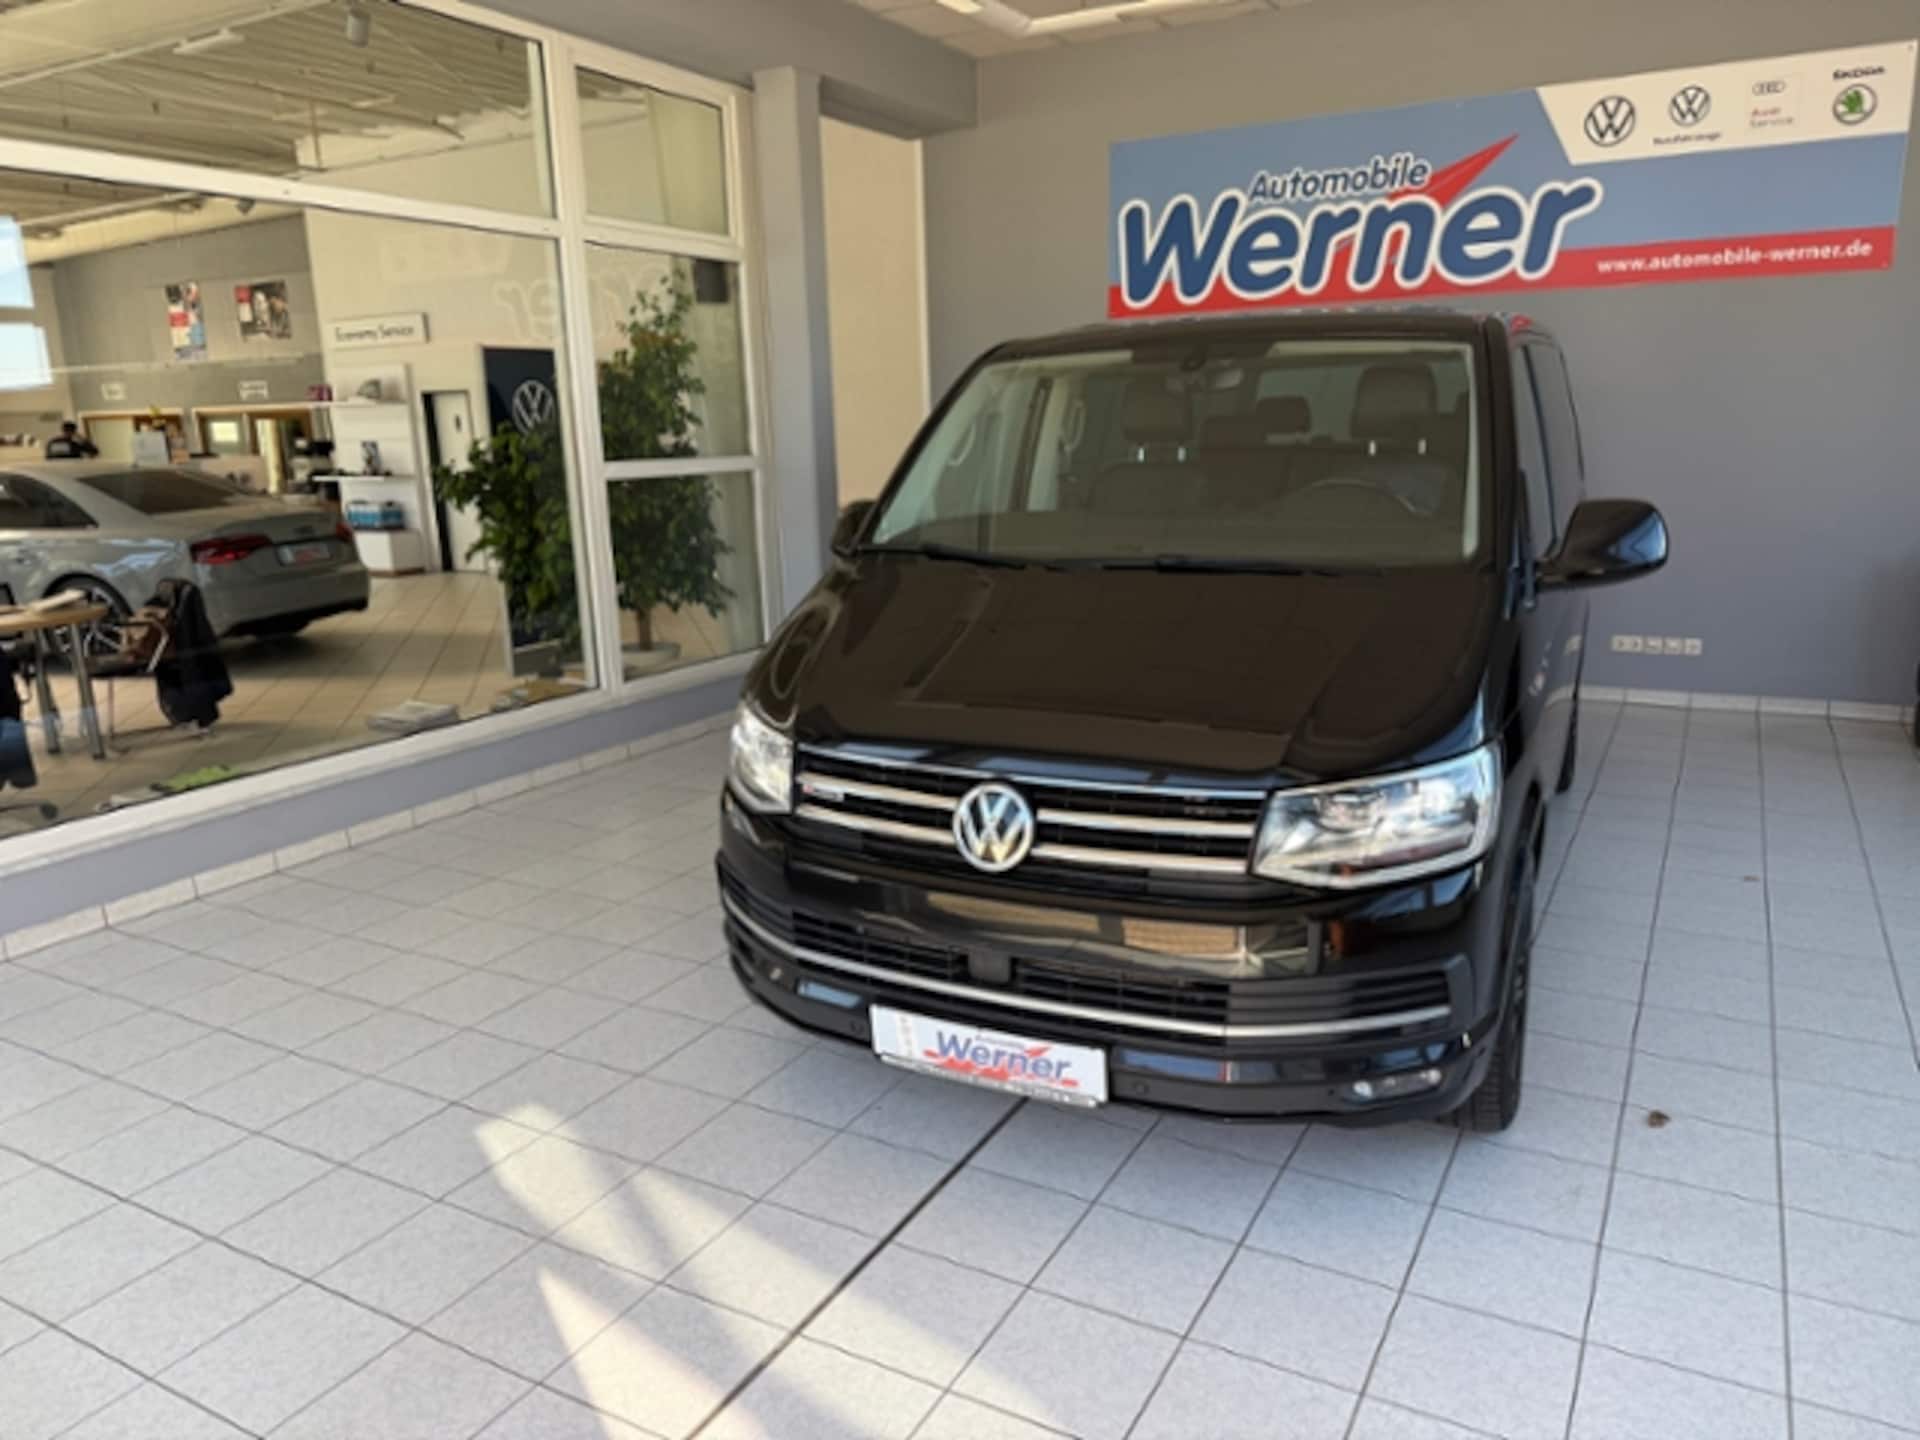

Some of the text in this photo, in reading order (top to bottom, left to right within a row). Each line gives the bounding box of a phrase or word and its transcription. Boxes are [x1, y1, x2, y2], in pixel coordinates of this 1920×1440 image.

[1249, 155, 1430, 200] Automobile
[1121, 181, 1602, 307] Werner
[1596, 239, 1873, 273] www.automobile-werner.de
[936, 1029, 1073, 1080] Werner
